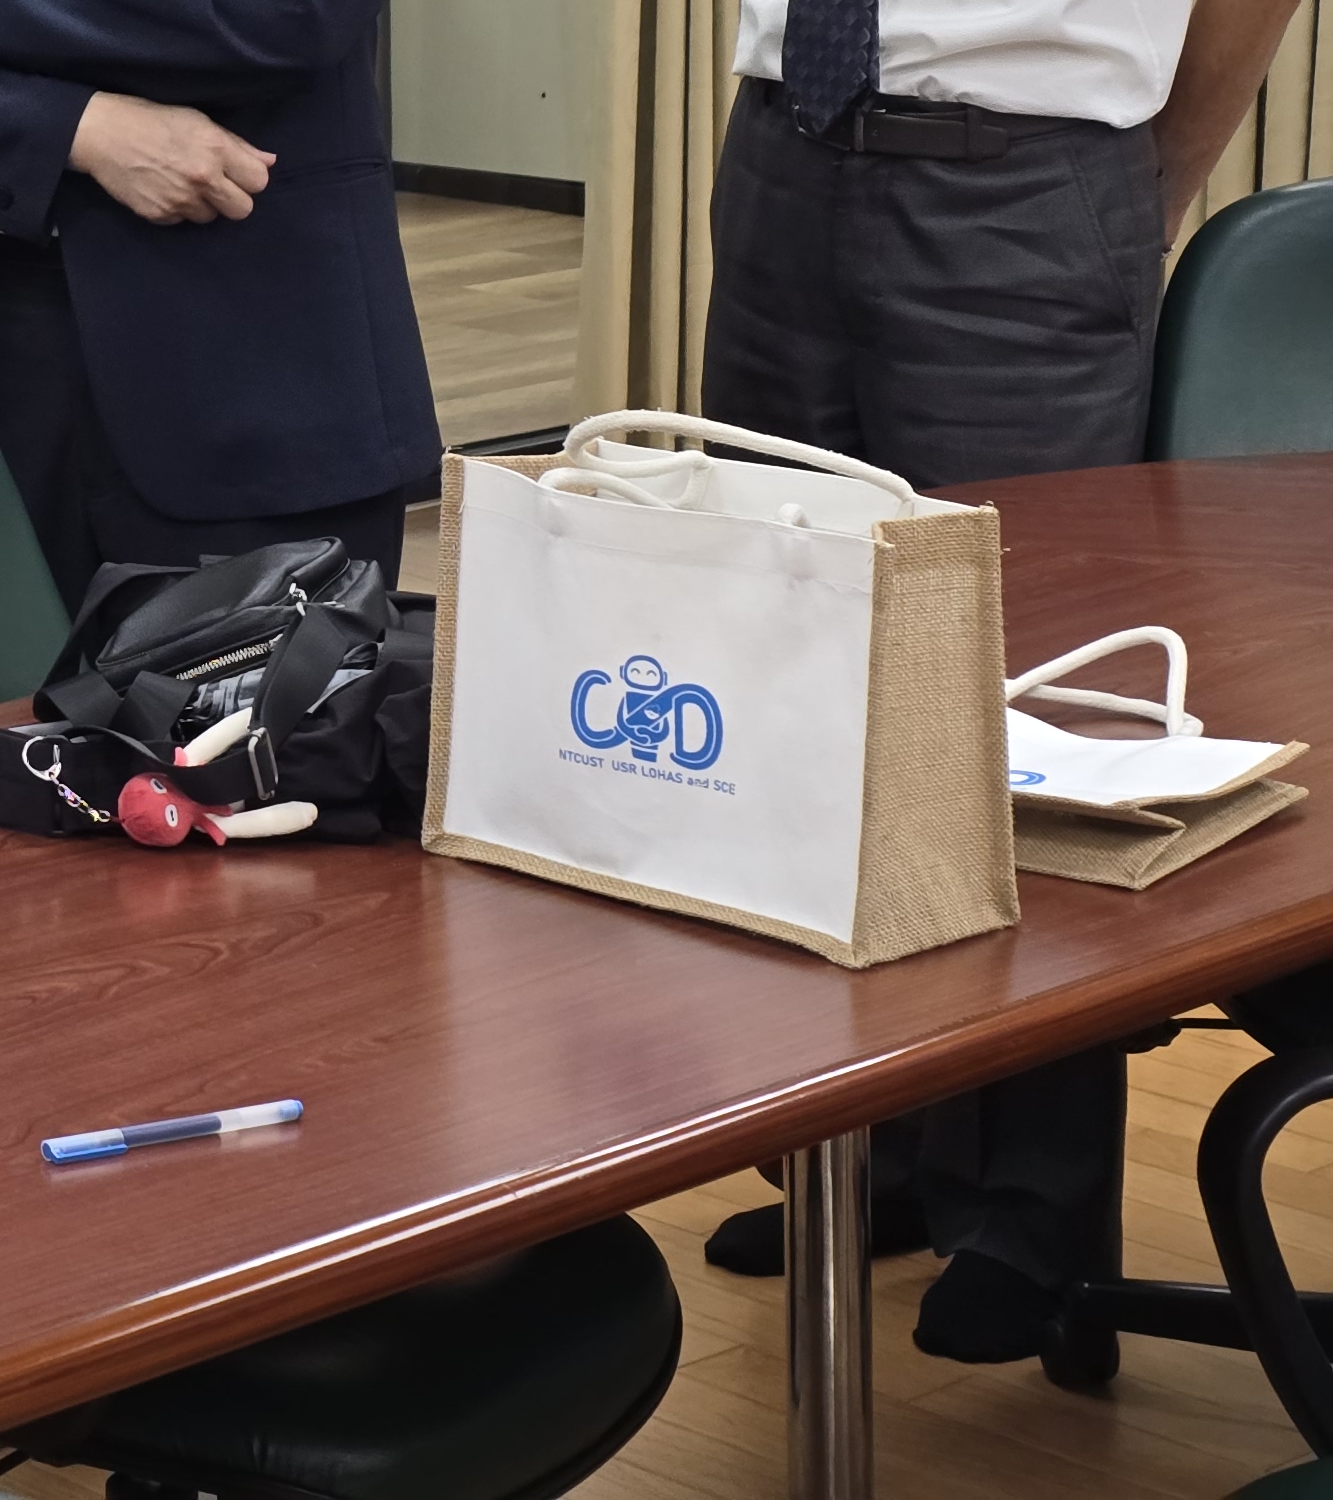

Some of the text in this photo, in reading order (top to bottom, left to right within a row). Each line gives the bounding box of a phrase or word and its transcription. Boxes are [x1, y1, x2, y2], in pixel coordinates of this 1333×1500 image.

[559, 748, 736, 796] NTCUST USR LOHAS and SCE
